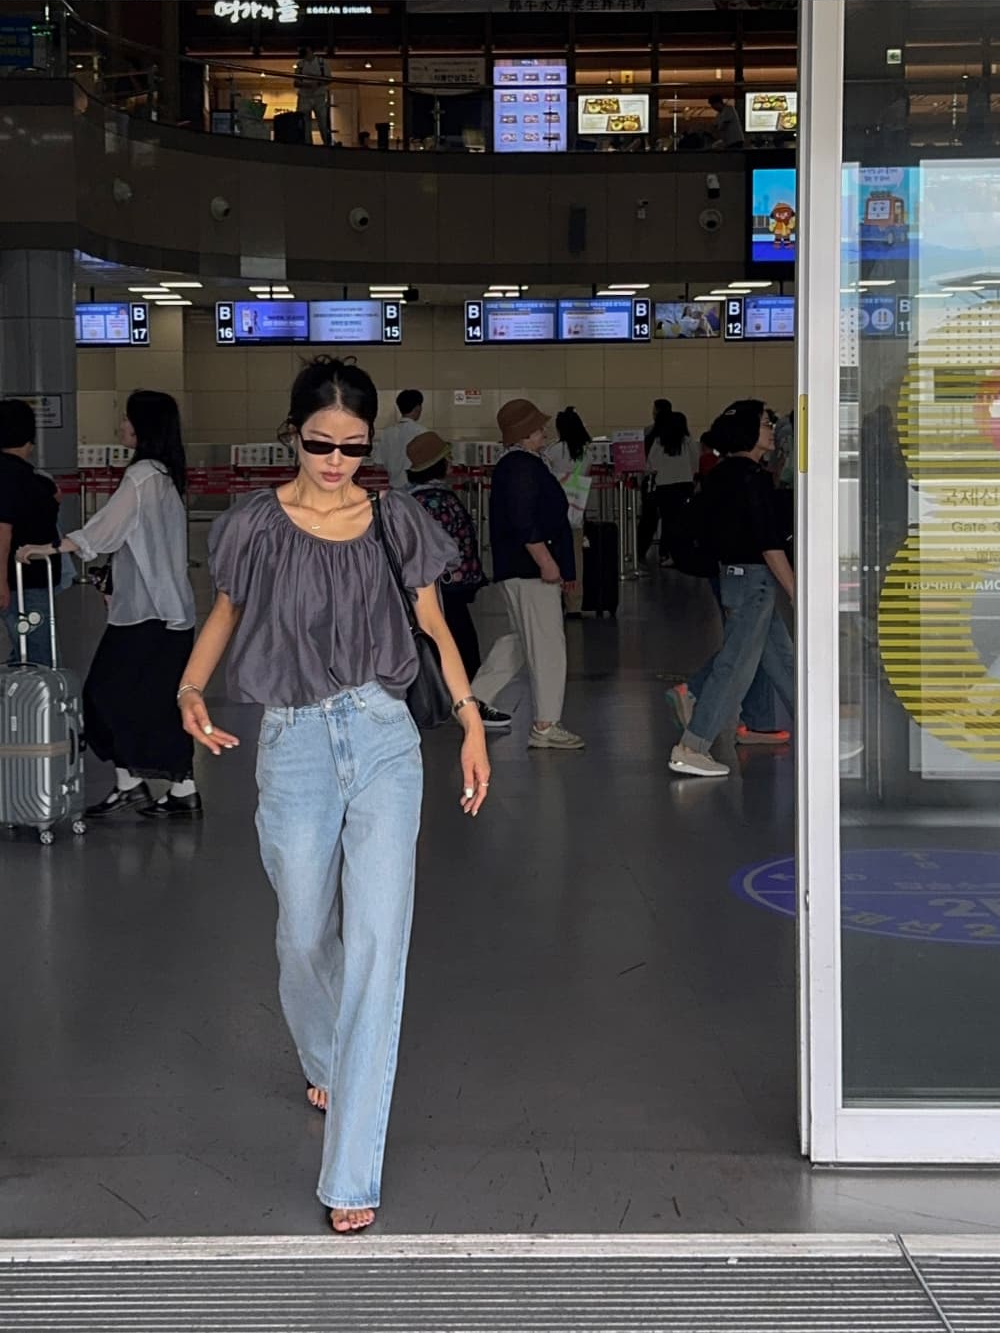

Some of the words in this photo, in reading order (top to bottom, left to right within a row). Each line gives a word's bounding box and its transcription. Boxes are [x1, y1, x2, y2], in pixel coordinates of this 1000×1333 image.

[133, 307, 145, 321] B
[219, 306, 231, 320] B
[386, 305, 398, 319] B
[468, 304, 480, 319] B
[635, 303, 647, 317] B
[728, 302, 740, 315] B
[132, 328, 147, 339] 17
[218, 327, 233, 339] 16
[384, 326, 399, 337] 15
[466, 325, 482, 337] 14
[634, 323, 649, 335] 13
[727, 322, 742, 334] 12
[951, 521, 986, 532] Gate
